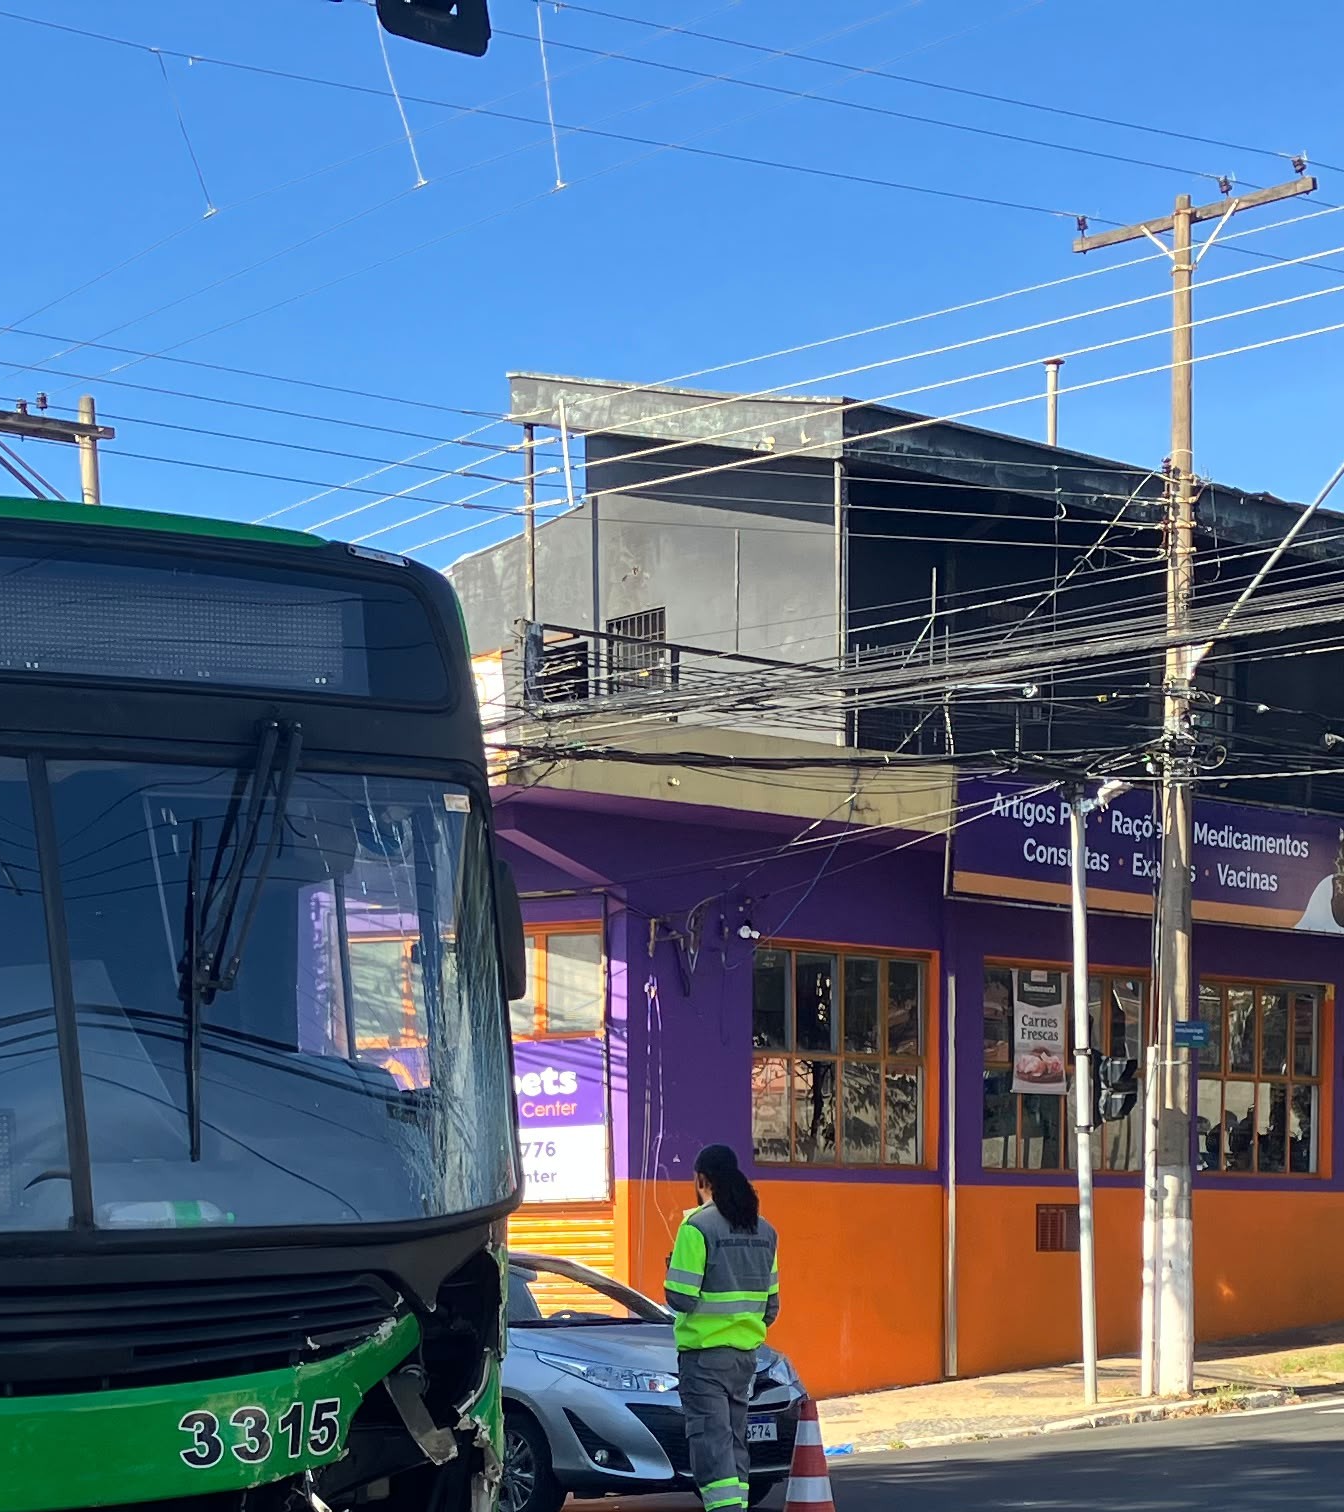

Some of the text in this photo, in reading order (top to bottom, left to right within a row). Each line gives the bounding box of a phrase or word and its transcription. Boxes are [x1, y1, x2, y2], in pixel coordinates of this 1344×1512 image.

[992, 792, 1055, 827] Artigos
[1194, 822, 1309, 858] Medicamentos
[1217, 863, 1278, 892] Vacinas
[1022, 1014, 1058, 1028] Carnes
[1021, 1028, 1059, 1041] Frescas
[521, 1101, 578, 1118] Center
[178, 1397, 341, 1469] 3315
